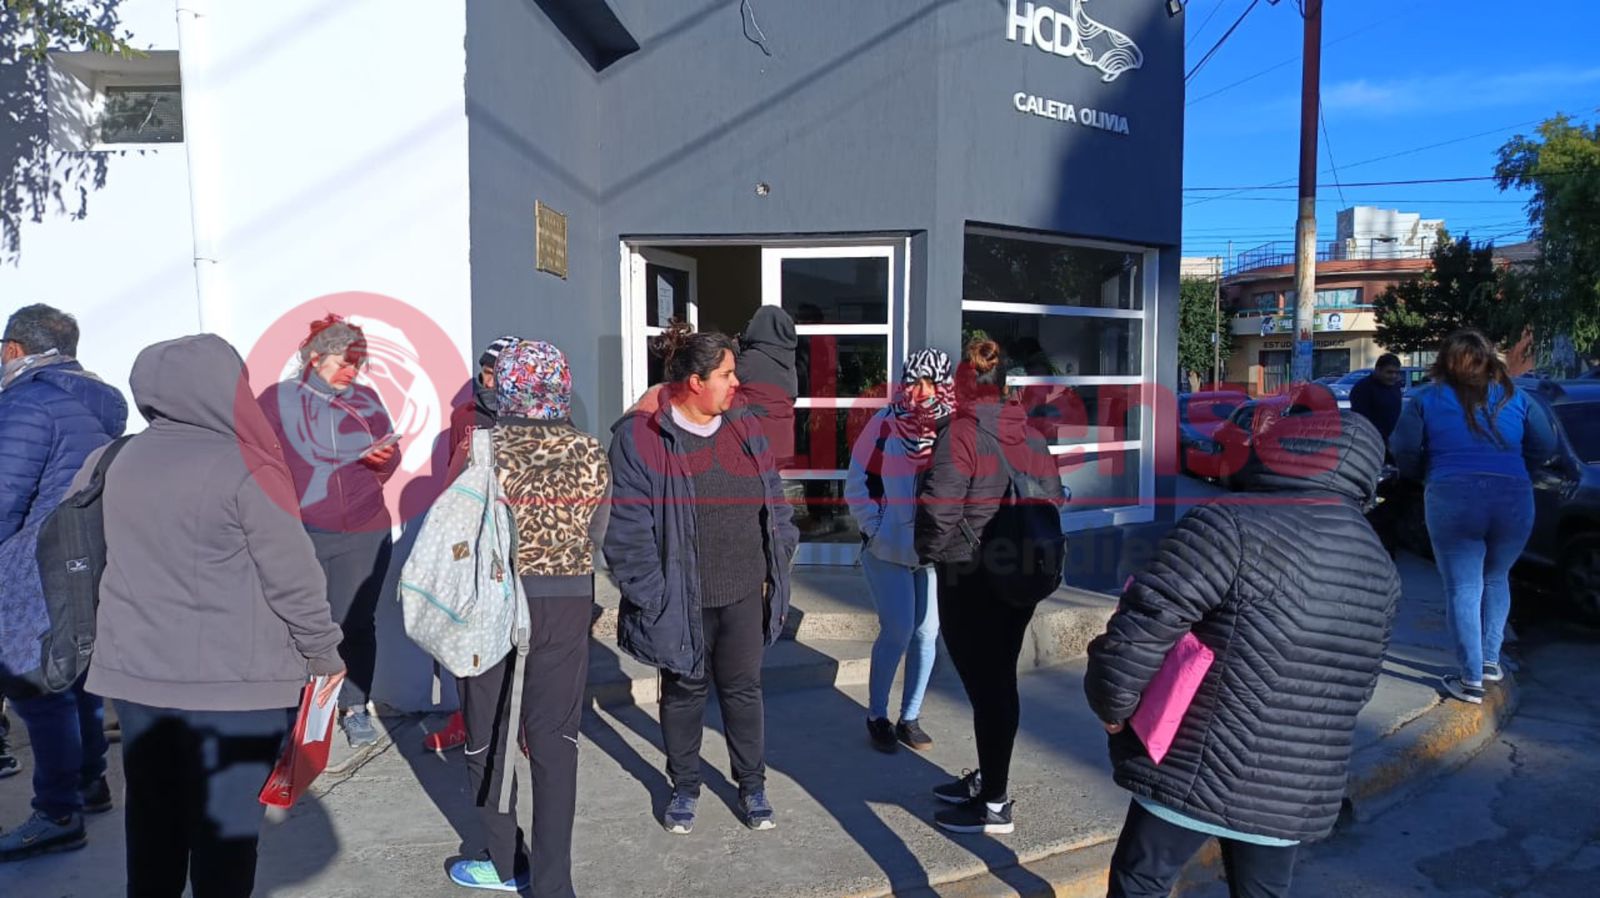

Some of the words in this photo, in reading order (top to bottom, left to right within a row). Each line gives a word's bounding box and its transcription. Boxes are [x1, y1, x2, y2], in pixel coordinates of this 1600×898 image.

[1007, 0, 1078, 56] HCD
[1013, 91, 1077, 122] CALETA
[1080, 108, 1129, 134] OLIVIA
